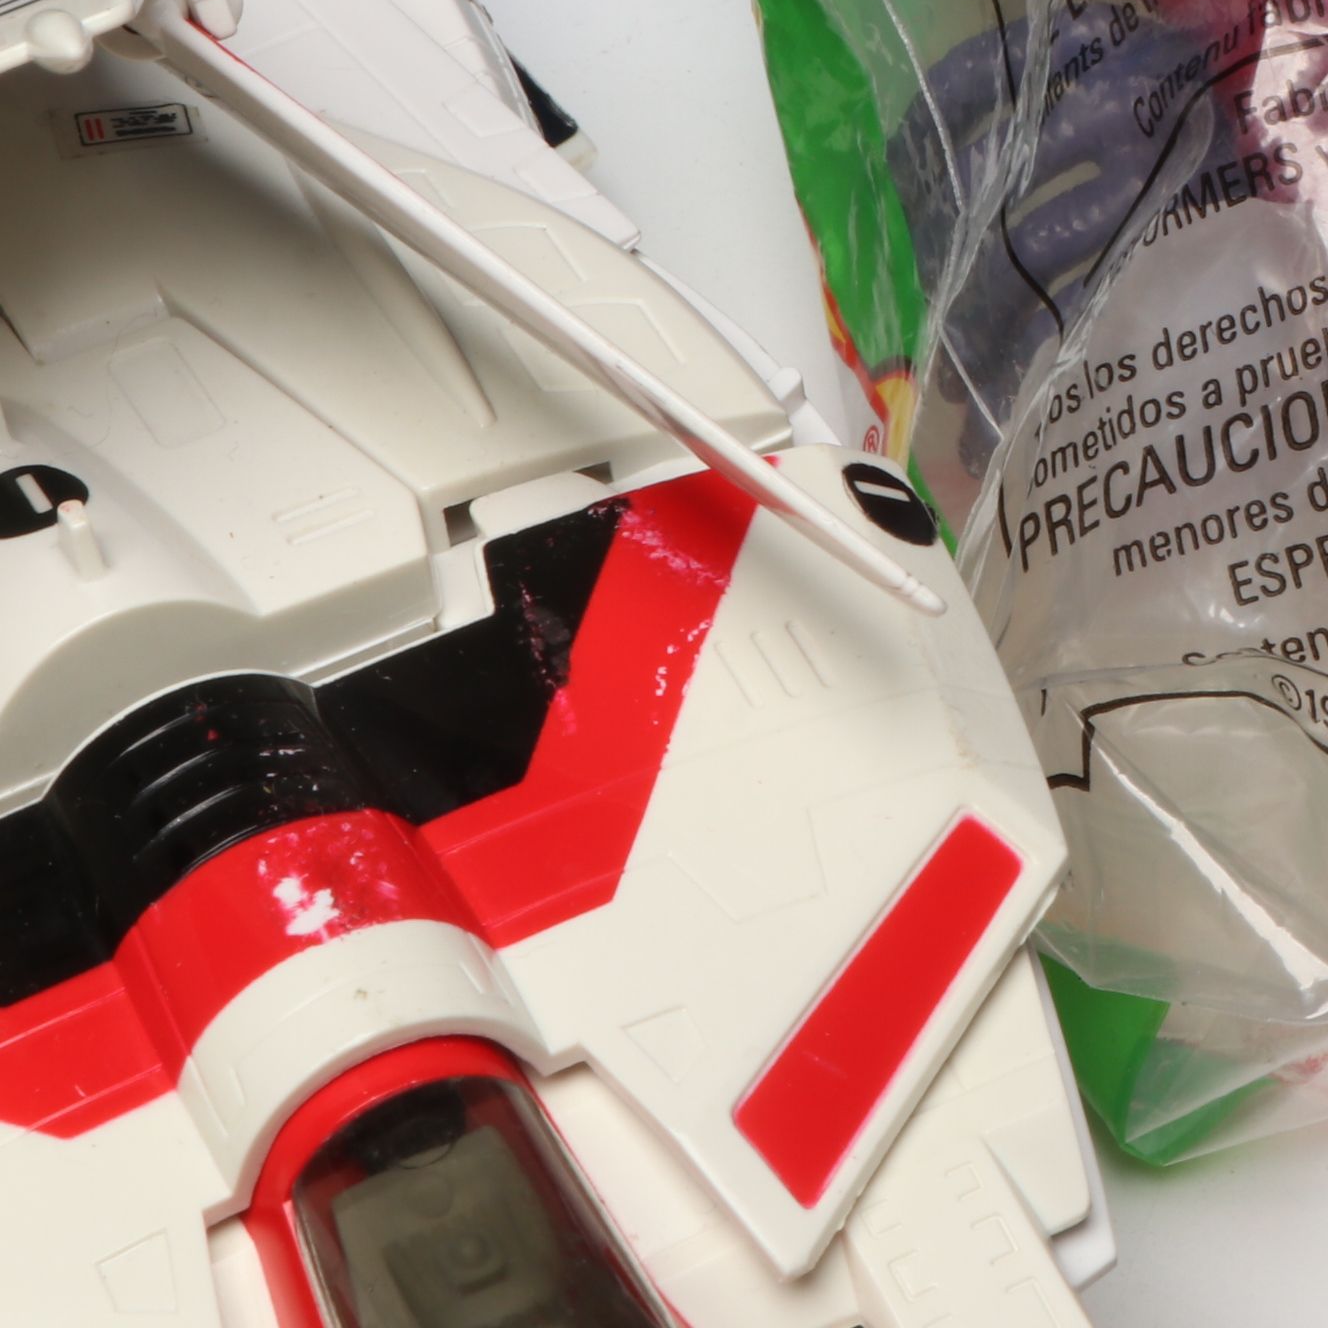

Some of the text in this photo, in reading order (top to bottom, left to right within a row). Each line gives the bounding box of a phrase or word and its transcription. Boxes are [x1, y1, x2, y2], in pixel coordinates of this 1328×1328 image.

[1109, 1, 1140, 48] de
[1133, 25, 1239, 138] Contenu
[1083, 353, 1136, 400] los
[1027, 391, 1187, 498] ometidos
[1201, 377, 1223, 410] a
[1112, 487, 1295, 576] menores
